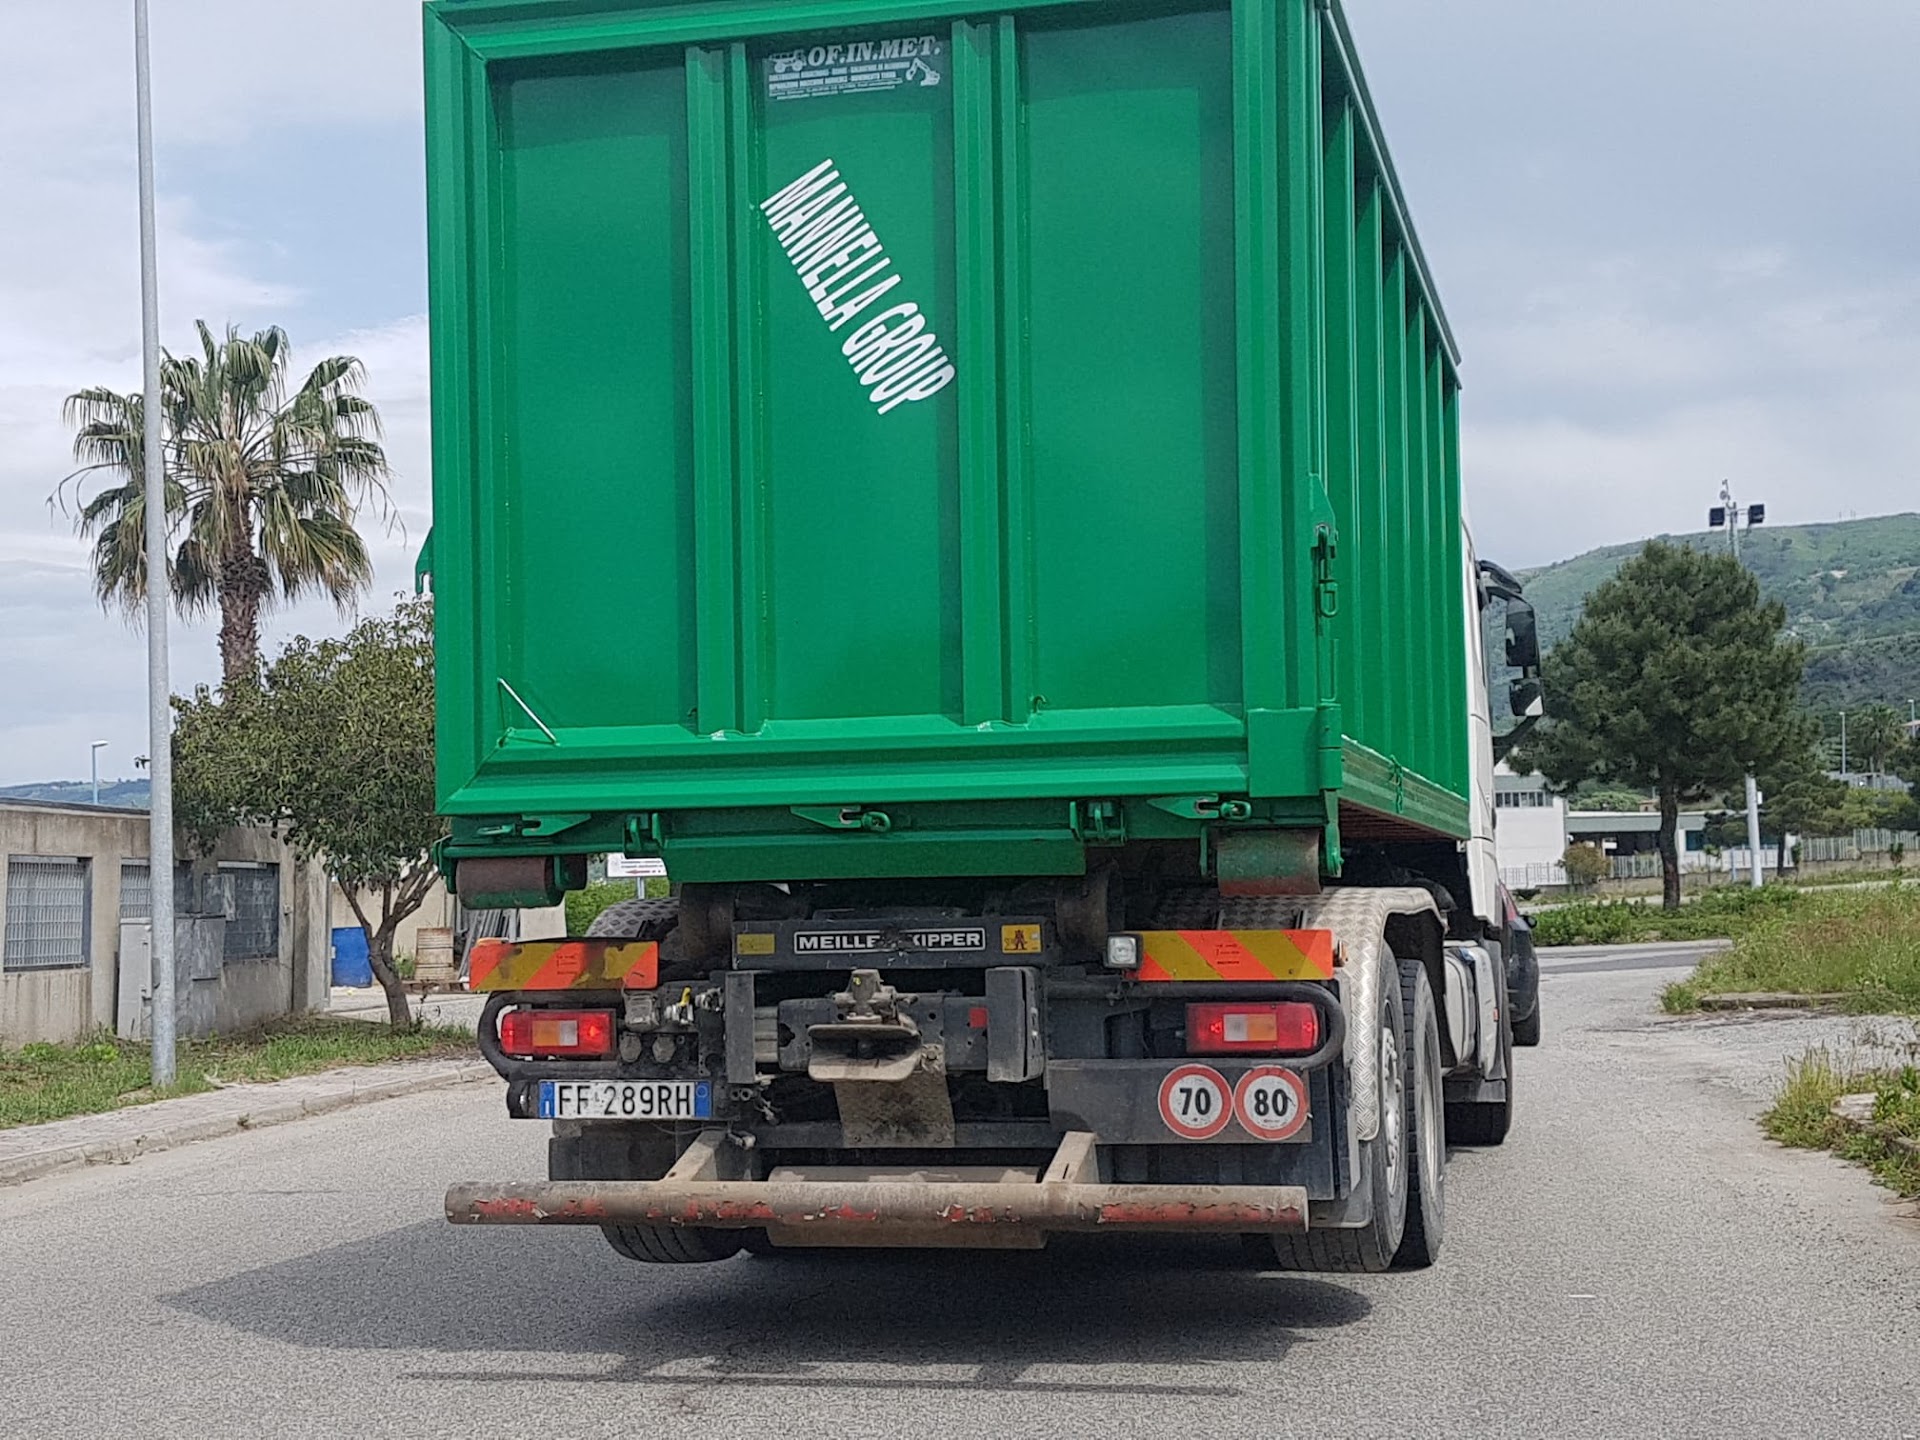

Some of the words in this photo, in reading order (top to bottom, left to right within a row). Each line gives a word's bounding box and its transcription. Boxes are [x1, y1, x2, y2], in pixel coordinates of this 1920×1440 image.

[807, 35, 941, 67] OF.IN.MET.
[759, 158, 902, 333] MANNELLA
[841, 302, 956, 415] GROUP
[799, 935, 892, 950] MEILLE
[1179, 1087, 1211, 1116] 70
[1254, 1088, 1288, 1117] 80
